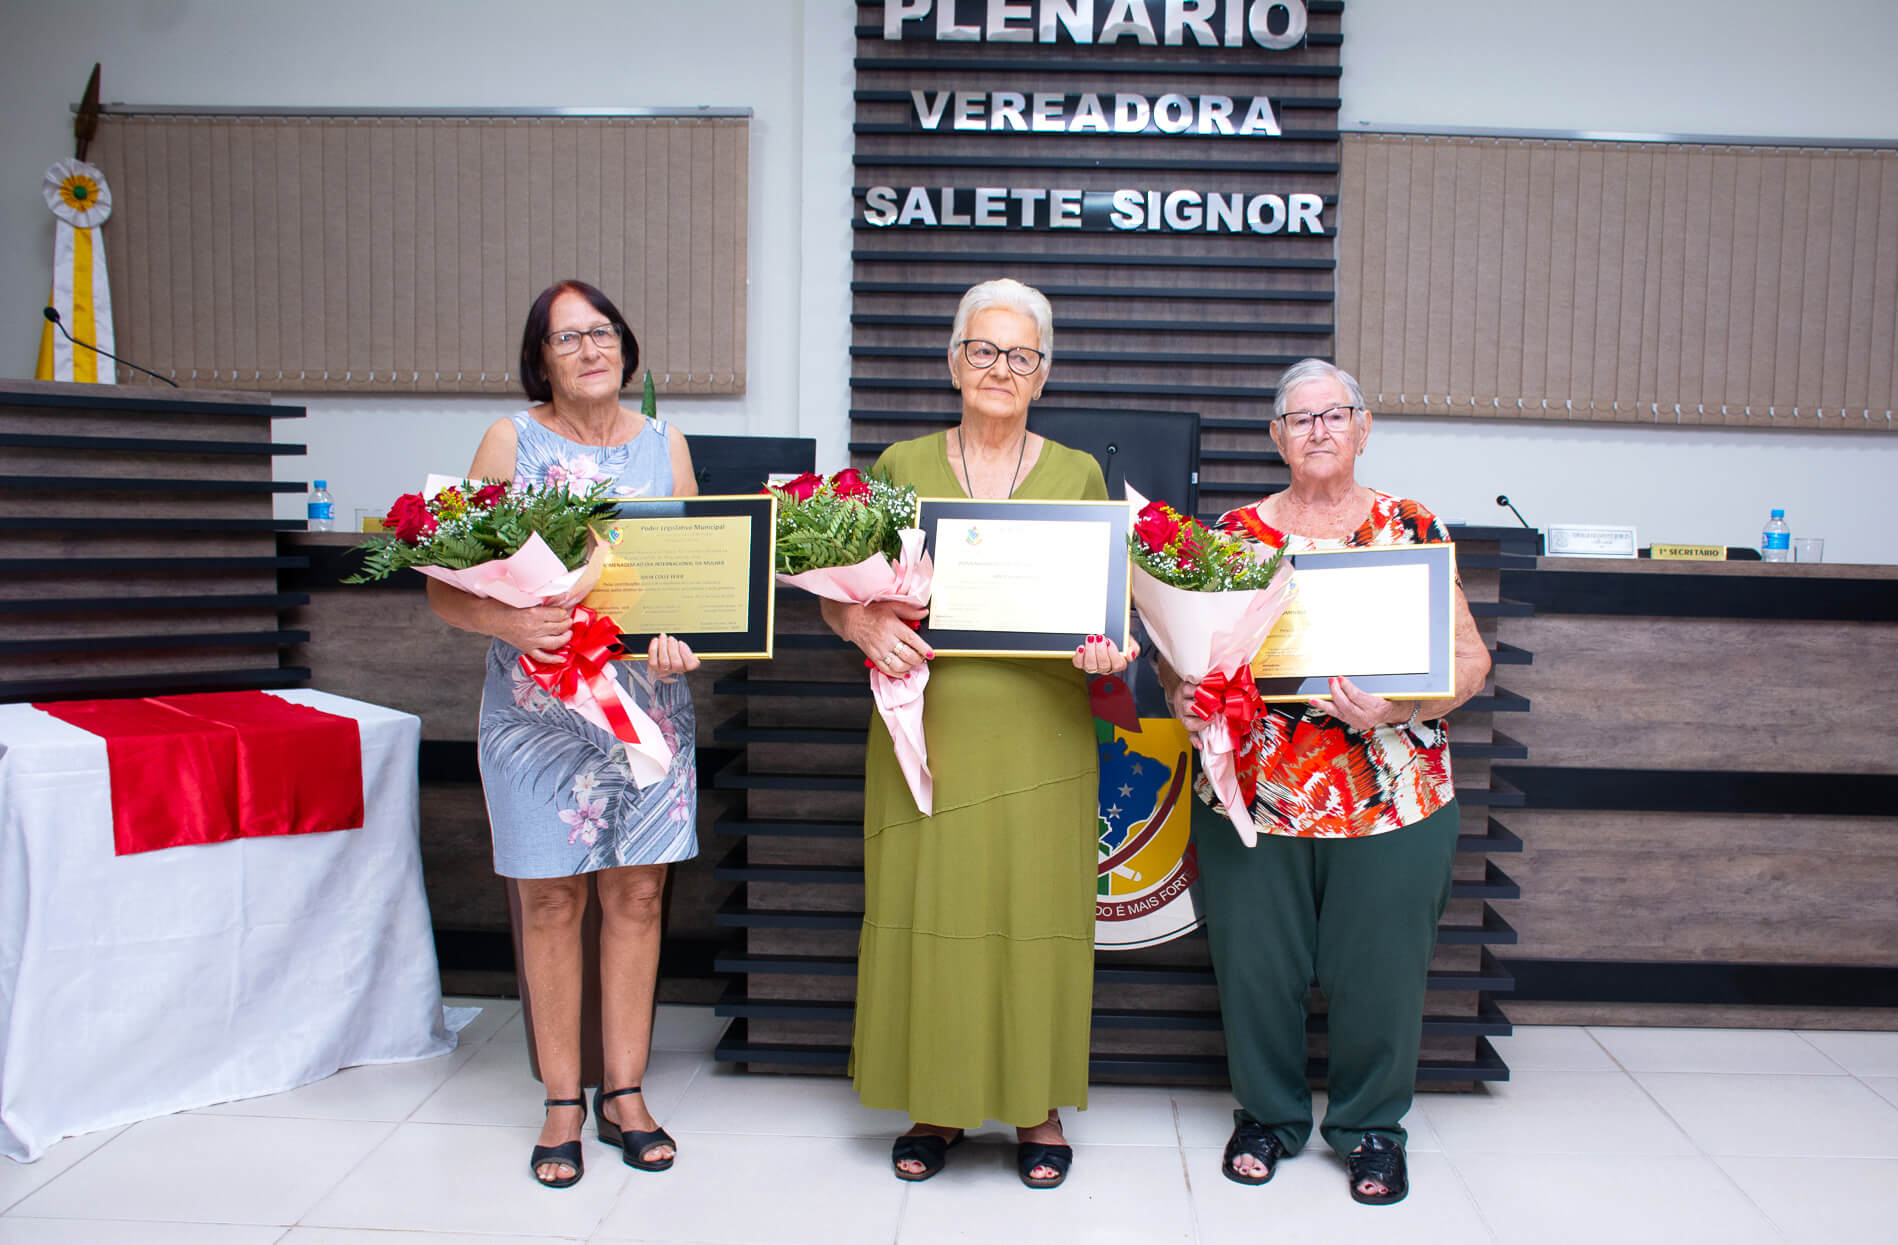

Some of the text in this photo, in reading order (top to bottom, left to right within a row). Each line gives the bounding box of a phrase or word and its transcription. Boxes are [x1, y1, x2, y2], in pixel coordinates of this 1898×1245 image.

[911, 90, 1282, 136] VEREADORA
[863, 186, 1326, 235] SALETE SIGNOR
[660, 524, 693, 532] Legislativo
[693, 523, 726, 531] Municipal
[1116, 903, 1126, 917] É
[1127, 896, 1160, 915] MAIS
[1159, 870, 1194, 902] FORT
